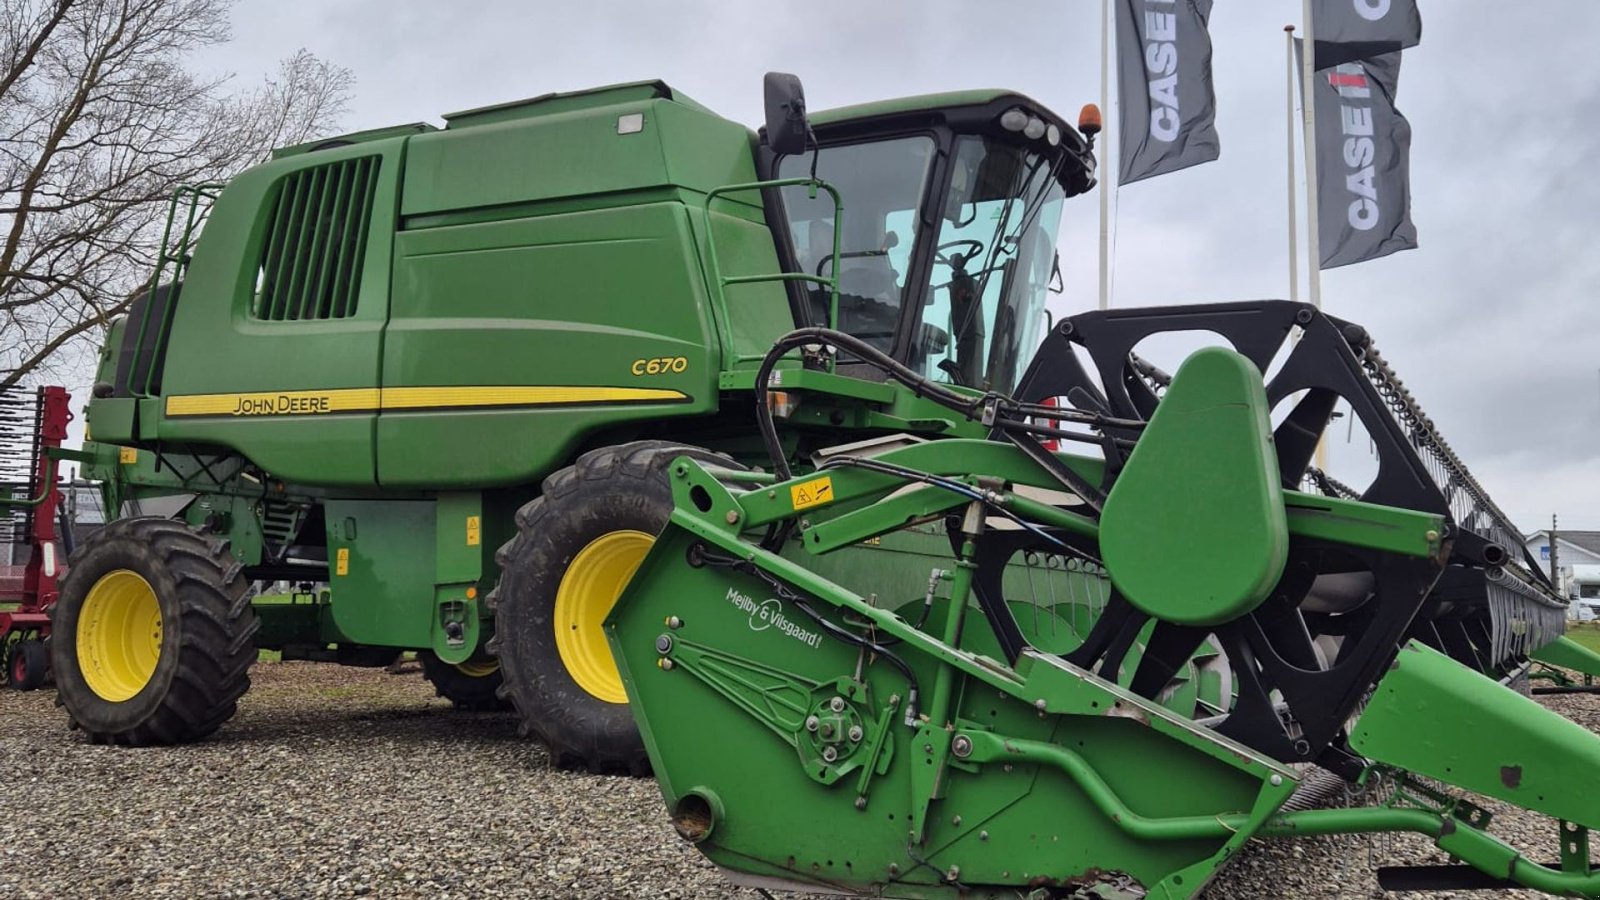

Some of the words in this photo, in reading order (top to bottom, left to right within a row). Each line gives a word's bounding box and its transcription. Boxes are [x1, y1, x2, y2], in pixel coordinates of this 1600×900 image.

[1145, 11, 1180, 142] CASE
[1341, 104, 1379, 231] CASE
[632, 357, 688, 375] C670
[233, 397, 274, 413] JOHN
[278, 395, 329, 412] DEERE
[726, 587, 760, 616] Mejlby
[760, 605, 770, 620] &
[770, 610, 818, 646] Vilsgaard
